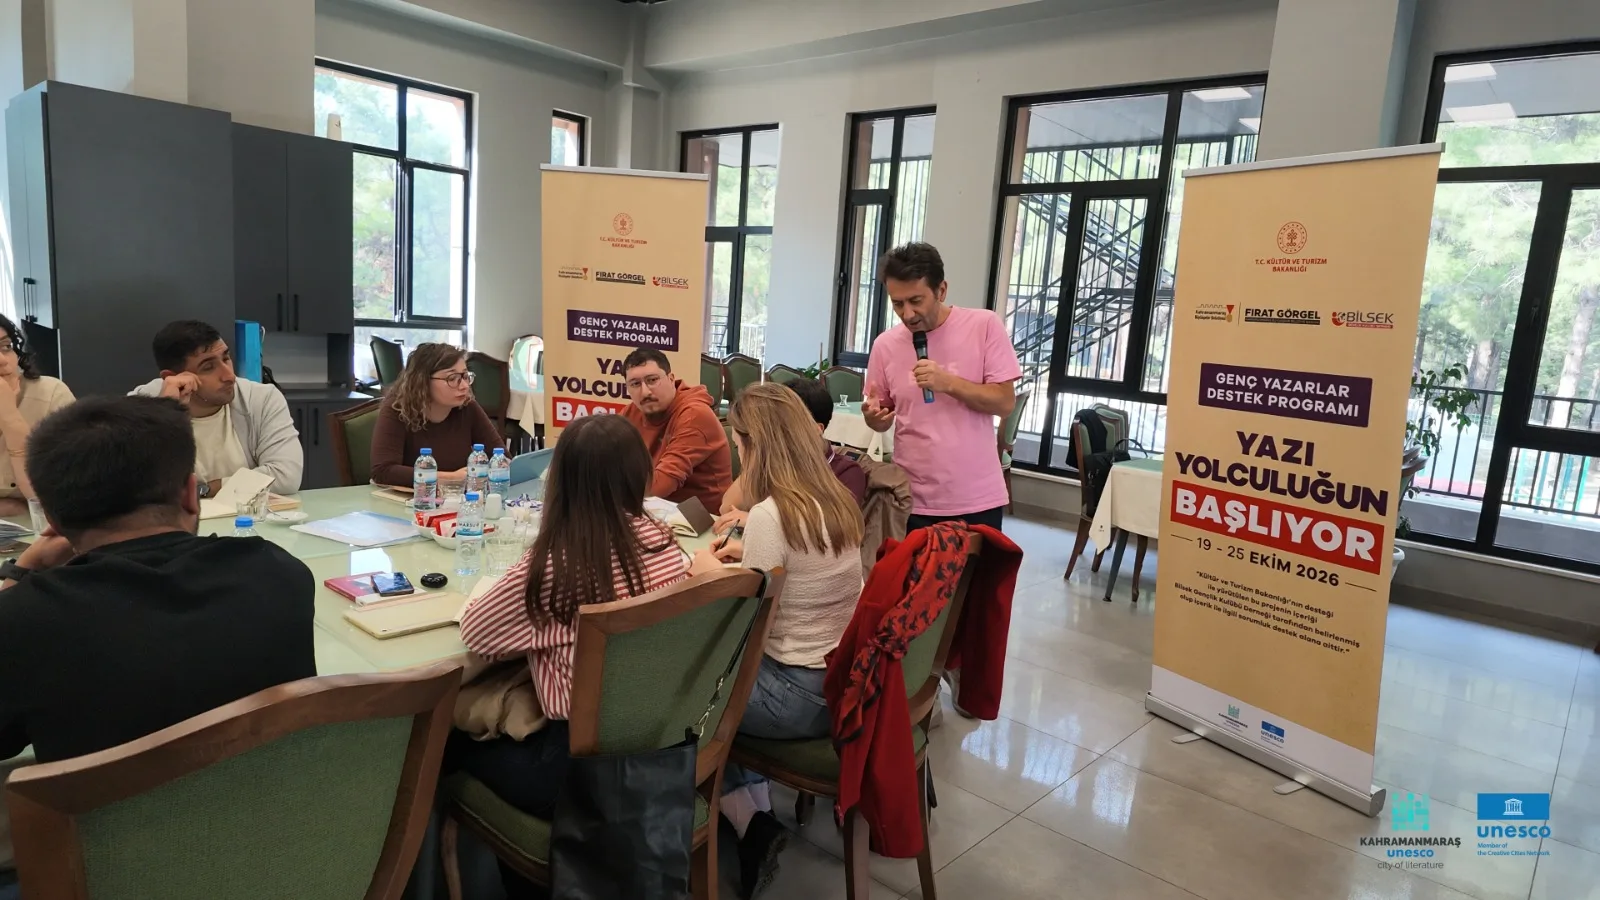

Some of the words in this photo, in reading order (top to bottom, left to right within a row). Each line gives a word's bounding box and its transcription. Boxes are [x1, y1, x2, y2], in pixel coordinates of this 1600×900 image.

[1273, 265, 1307, 273] BAKANLIĞI
[1302, 257, 1327, 265] TURİZM
[596, 271, 615, 279] FIRAT
[579, 316, 608, 328] GENÇ
[612, 320, 667, 334] YAZARLAR
[1245, 308, 1274, 317] FIRAT
[1277, 308, 1321, 319] GÖRGEL
[1346, 310, 1394, 324] BİLSEK
[573, 327, 613, 340] DESTEK
[616, 331, 673, 346] PROGRAMI
[597, 357, 626, 376] YA
[1216, 373, 1258, 389] GENÇ
[1262, 377, 1350, 398] YAZARLAR
[1207, 387, 1263, 405] DESTEK
[1267, 395, 1359, 417] PROGRAMI
[1236, 430, 1315, 467] YAZI
[1175, 451, 1389, 517] YOLCULUĞUN
[1175, 487, 1375, 562] BAŞLIYOR
[1197, 537, 1212, 551] 19
[1227, 545, 1246, 560] 25
[1249, 551, 1291, 573] EKİM
[1296, 564, 1340, 587] 2026
[1207, 583, 1216, 591] ile
[1216, 588, 1250, 602] yürütülen
[1251, 597, 1260, 605] bu
[1261, 601, 1292, 615] projenin
[1293, 610, 1318, 624] içeriği
[1230, 581, 1254, 593] Turizm
[1304, 604, 1334, 619] desteği
[1174, 582, 1193, 593] Bilsek
[1193, 588, 1218, 601] Gençlik
[1219, 597, 1242, 609] Kulübü
[1243, 604, 1272, 619] Derneği
[1272, 614, 1313, 633] tarafından
[1315, 627, 1360, 649] belirlenmiş
[1194, 597, 1213, 609] içerik
[1213, 603, 1222, 612] ile
[1222, 606, 1238, 617] ilgili
[1272, 624, 1298, 638] destek
[1299, 634, 1321, 646] alana
